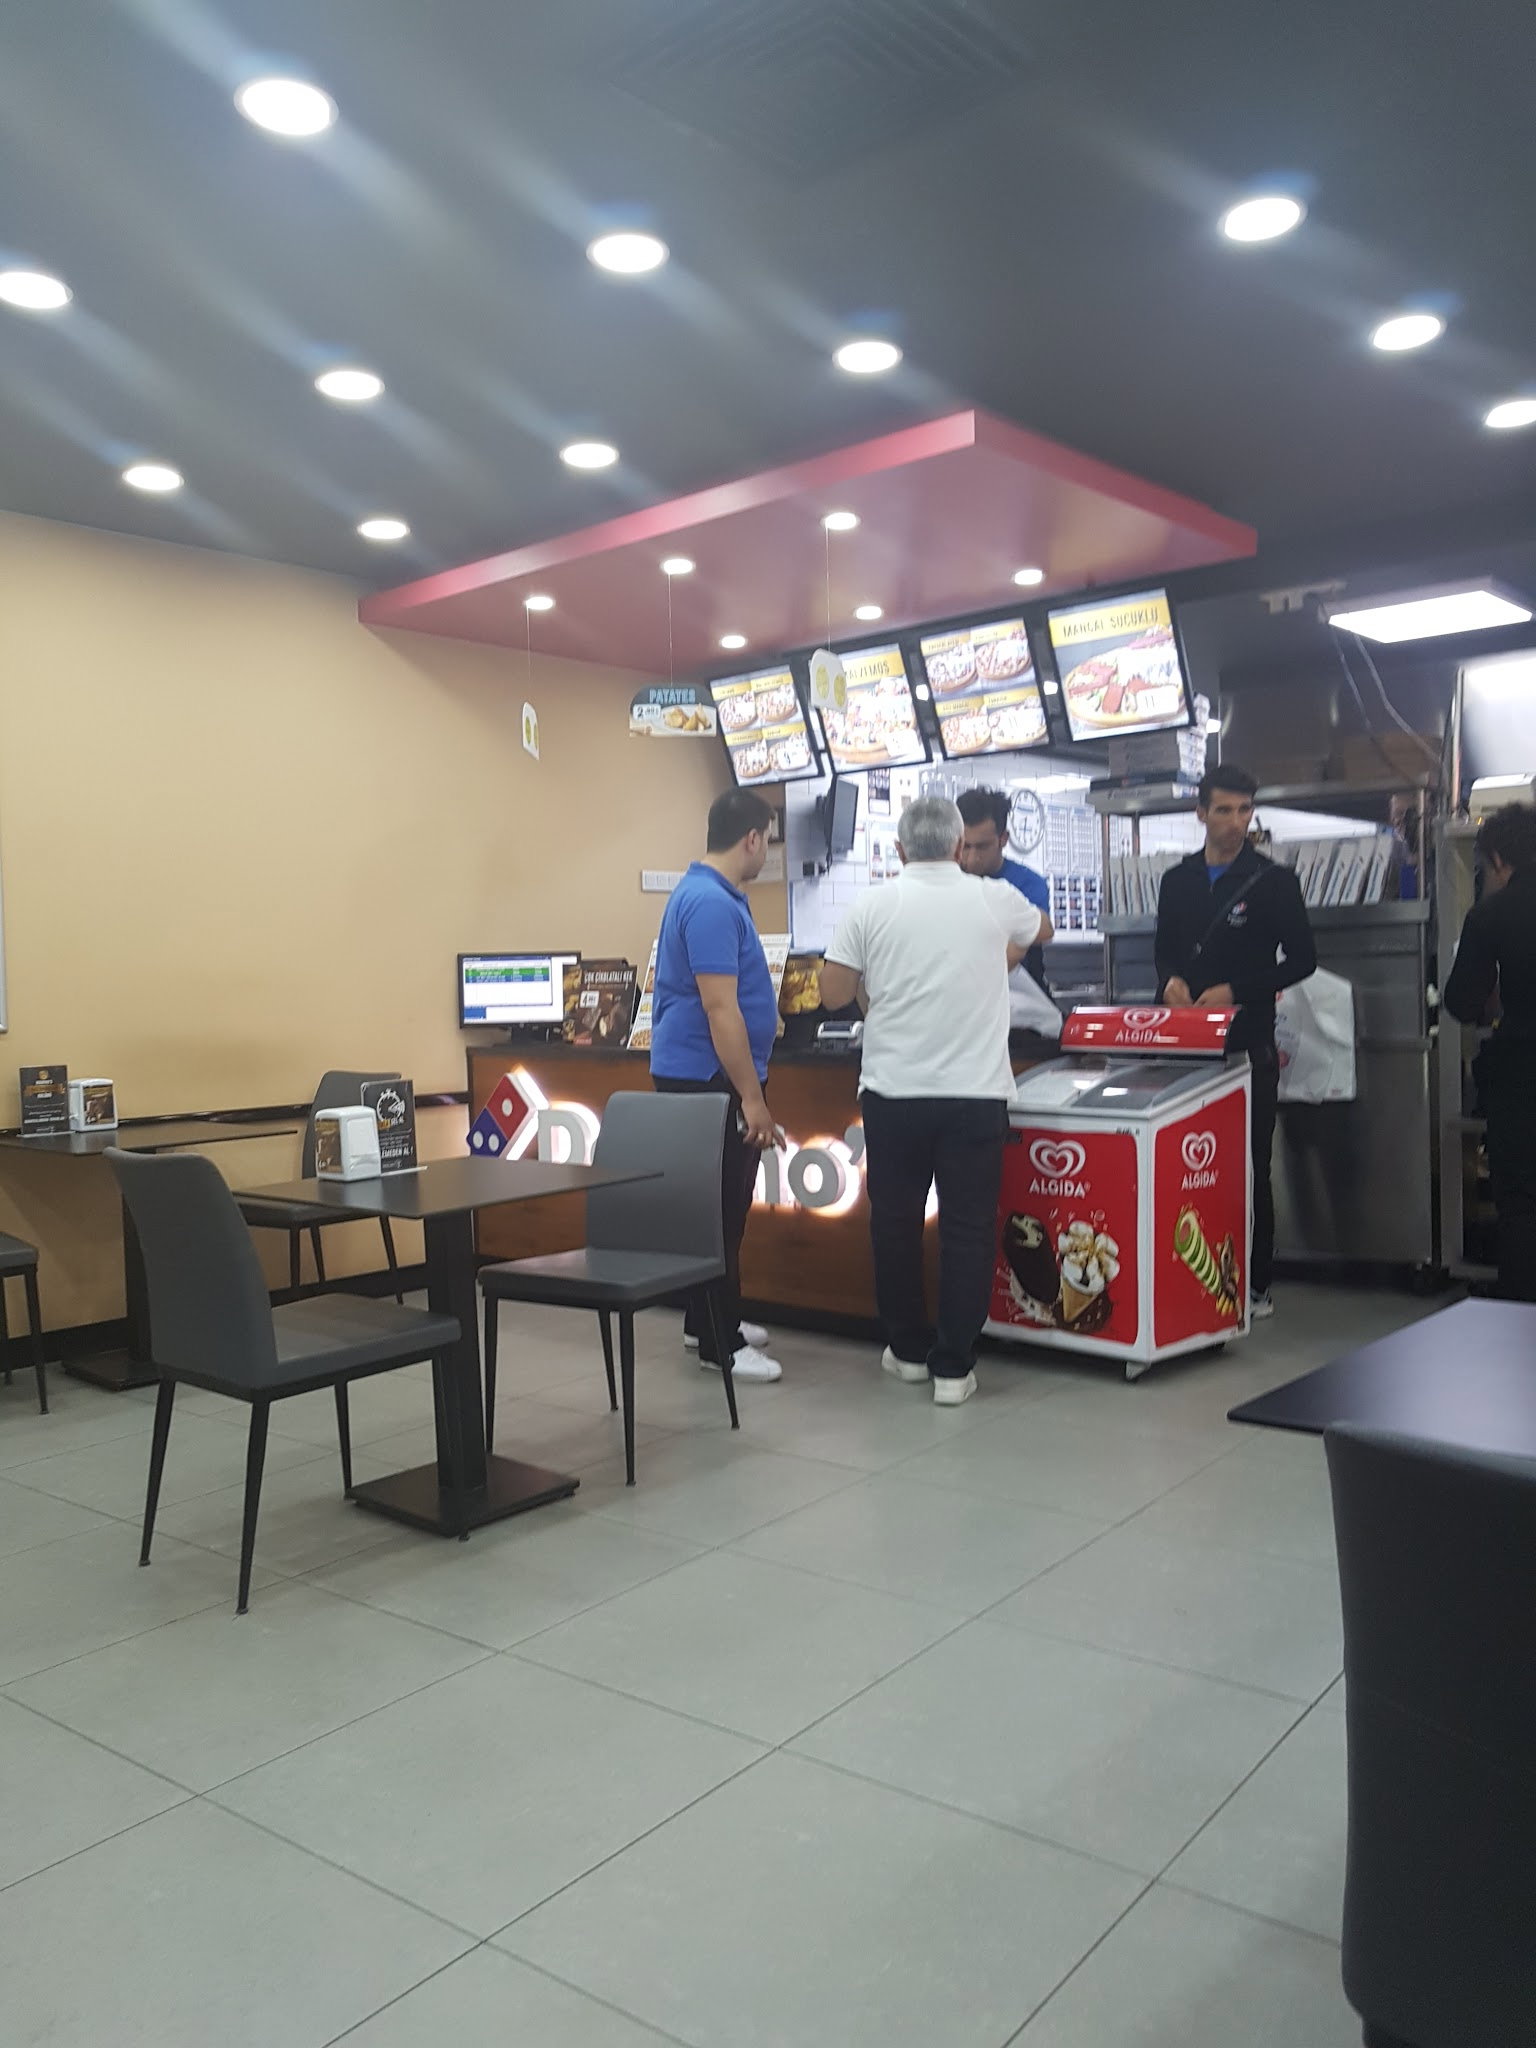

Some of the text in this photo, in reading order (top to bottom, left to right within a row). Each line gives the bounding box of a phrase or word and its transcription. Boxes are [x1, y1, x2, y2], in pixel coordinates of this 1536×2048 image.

[1114, 1029, 1161, 1044] ALGIDA
[1029, 1178, 1086, 1199] ALGIDA
[1181, 1171, 1216, 1191] ALGIDA
